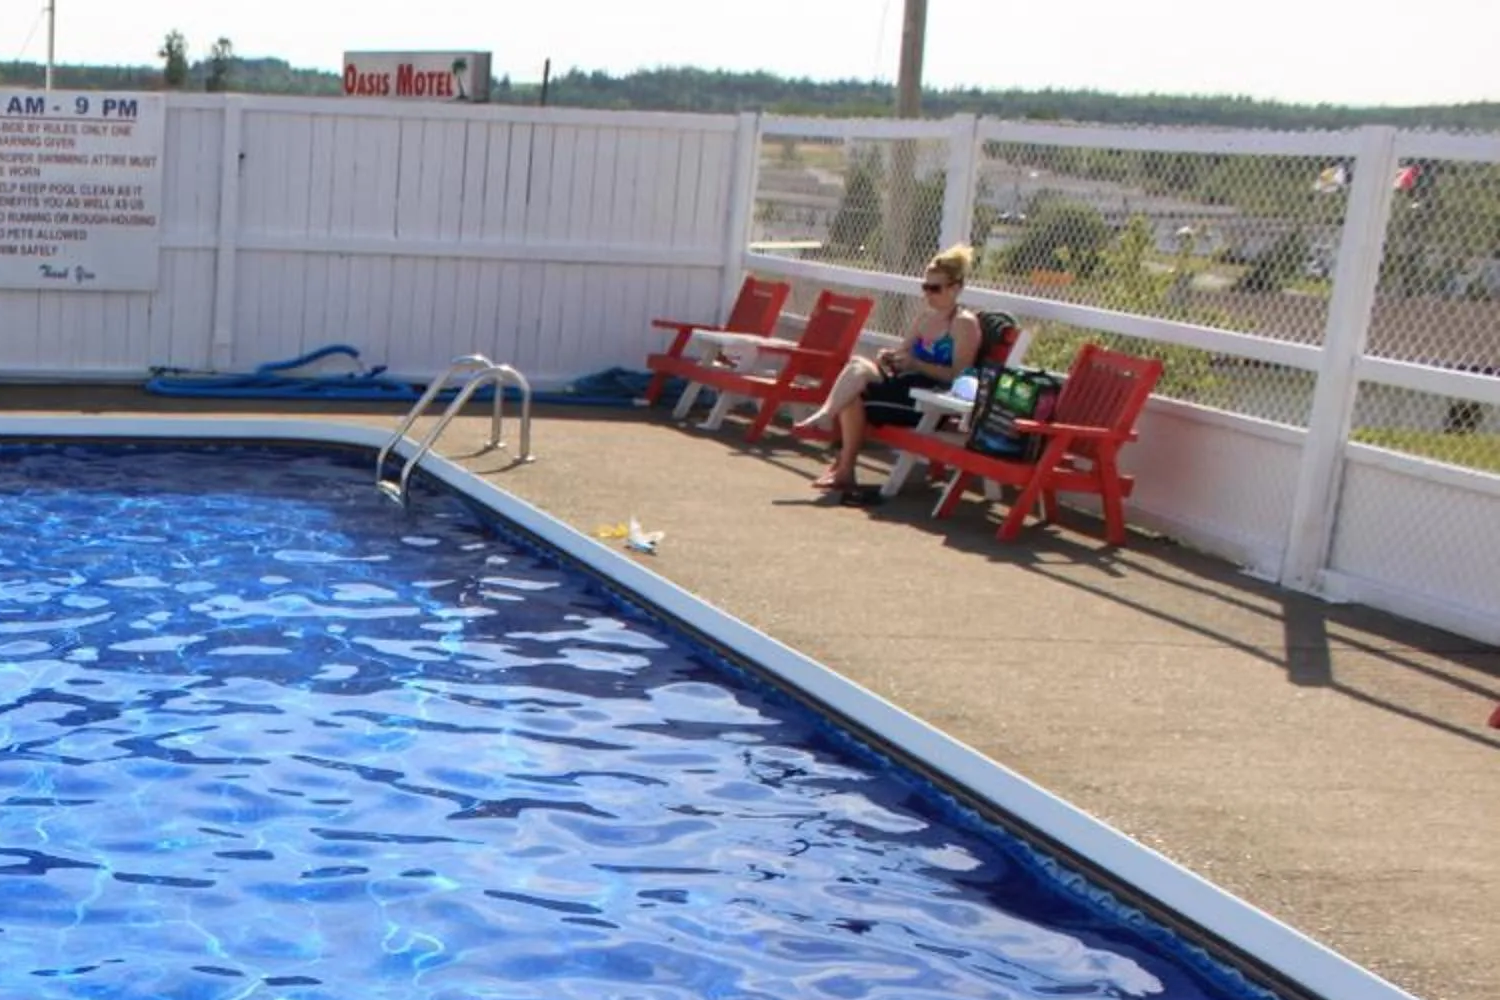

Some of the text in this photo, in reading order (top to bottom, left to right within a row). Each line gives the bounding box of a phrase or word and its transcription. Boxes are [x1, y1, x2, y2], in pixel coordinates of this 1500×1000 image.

[344, 63, 453, 96] OASIS MOTEL
[7, 96, 45, 114] AM
[75, 96, 89, 115] 9
[102, 98, 138, 117] PM
[27, 123, 40, 133] BY
[81, 124, 109, 136] ONLY
[111, 125, 132, 136] ONE
[44, 137, 75, 148] GIVEN
[38, 153, 88, 165] SWIMMING
[90, 153, 126, 166] ATTIRE
[129, 155, 157, 168] MUST
[9, 166, 40, 177] WORN
[20, 183, 46, 194] KEEP
[49, 183, 77, 195] POOL
[80, 184, 115, 196] CLEAN
[117, 185, 130, 196] AS
[133, 185, 142, 196] IT
[43, 197, 63, 208] YOU
[65, 197, 80, 208] AS
[83, 198, 110, 210] WELL
[114, 198, 127, 210] AS
[130, 199, 145, 210] US
[7, 212, 52, 224] RUNNING
[54, 212, 69, 224] OR
[7, 228, 33, 240] PETS
[36, 229, 88, 241] ALLOWED
[20, 245, 58, 257] SAFELY
